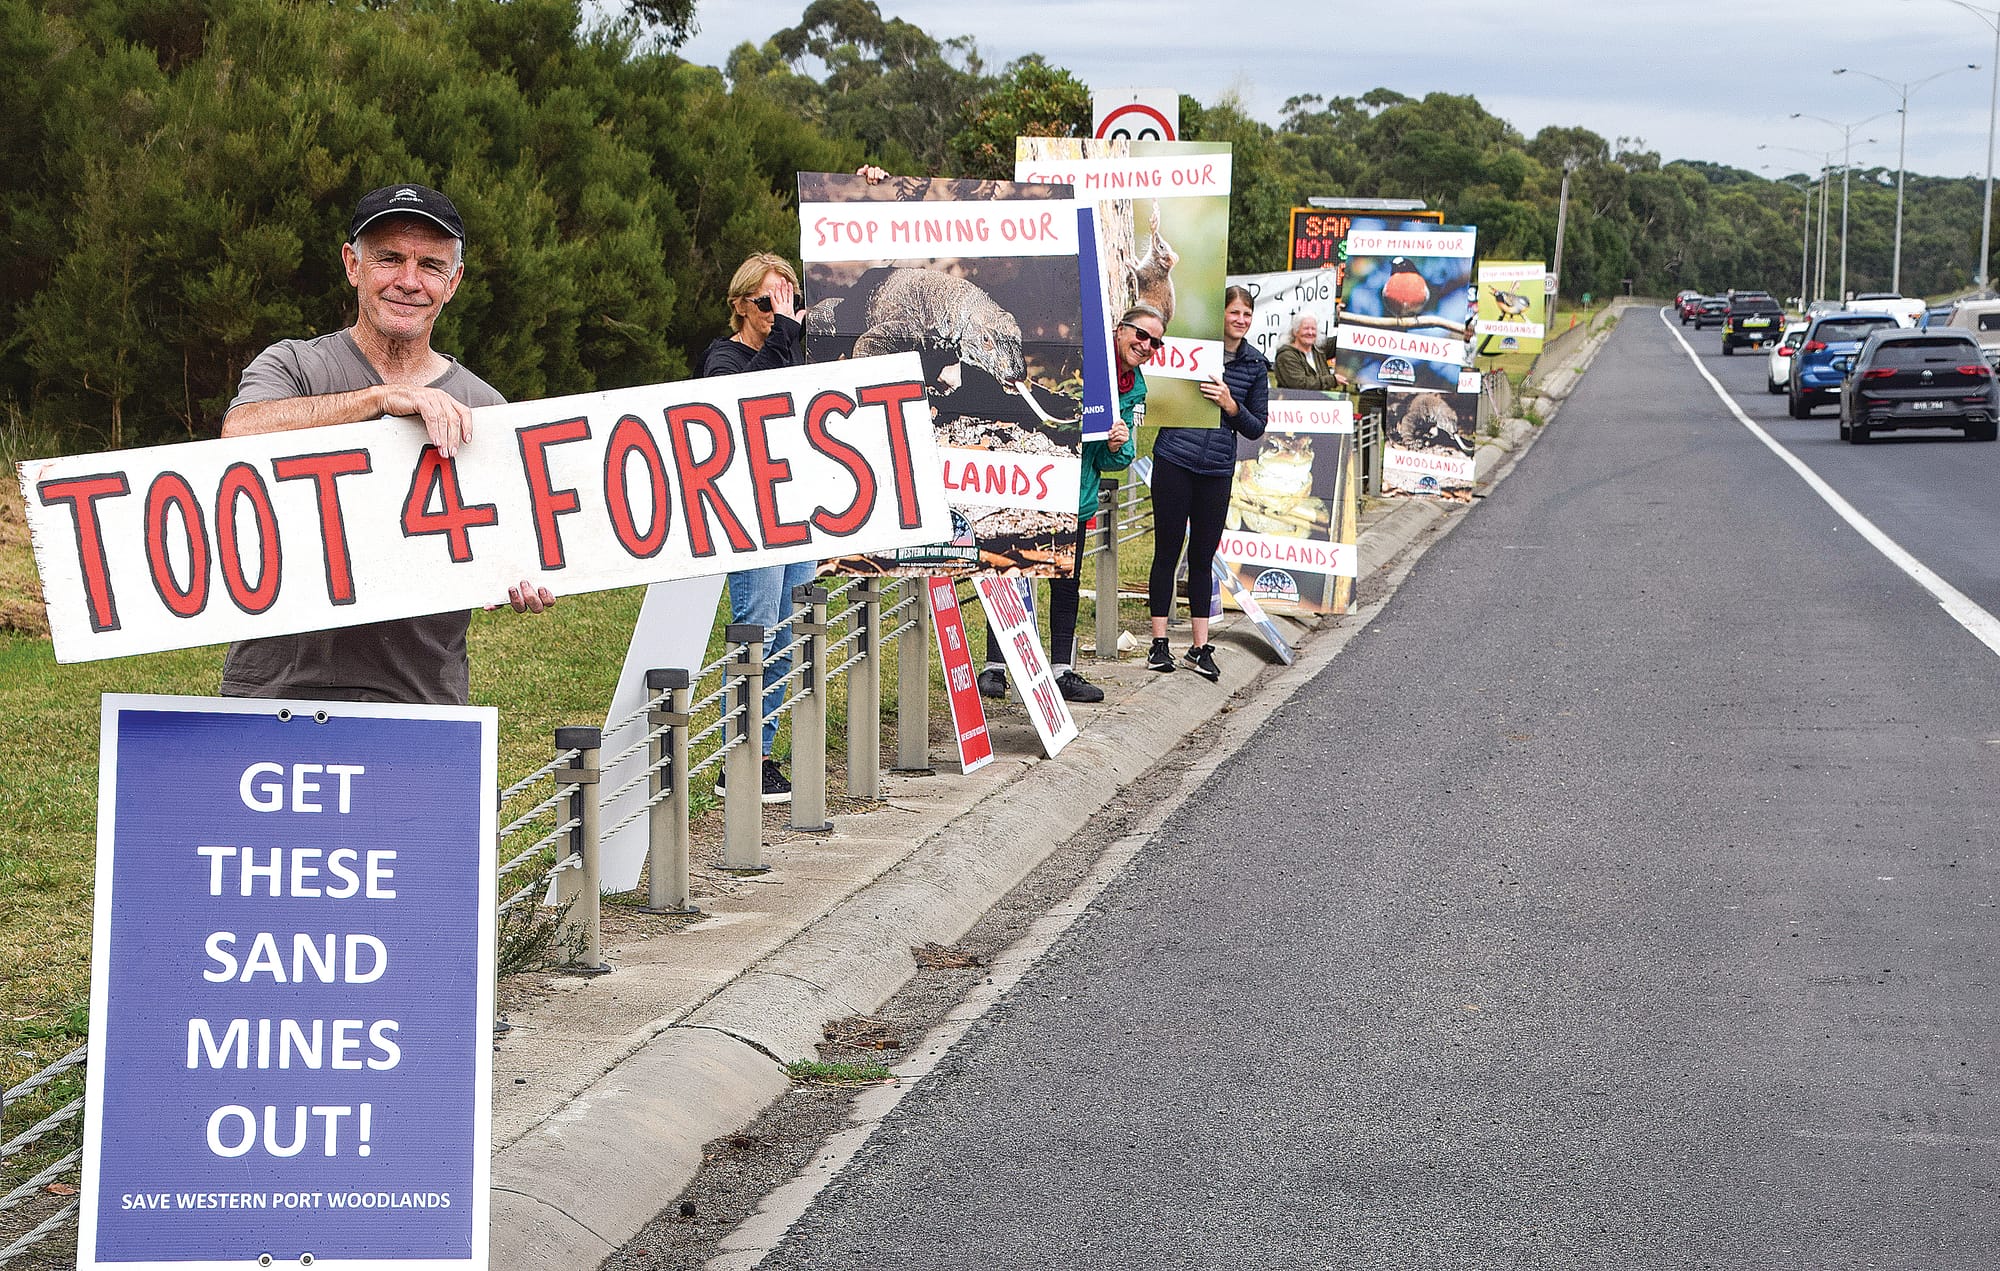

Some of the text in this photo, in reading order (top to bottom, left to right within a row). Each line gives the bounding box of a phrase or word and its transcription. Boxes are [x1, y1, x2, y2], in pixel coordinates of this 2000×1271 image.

[1085, 169, 1162, 189] MINING
[1171, 164, 1215, 185] OUR
[814, 212, 1058, 246] STOP MINING OUR
[1353, 236, 1464, 251] STOP MINING OUR
[1295, 275, 1330, 302] hole
[1265, 311, 1280, 326] in
[1352, 331, 1452, 358] WOODLANDS
[1310, 409, 1343, 425] OUR
[1395, 454, 1466, 475] WOODLANDS
[37, 380, 927, 634] TOOT 4 FOREST
[899, 546, 978, 561] WESTERN PORT WOODLANDS
[1013, 630, 1042, 682] PER
[239, 762, 365, 814] GET
[197, 846, 397, 899] THESE
[203, 931, 388, 984] SAND
[186, 1018, 402, 1071] MINES
[206, 1102, 372, 1158] OUT!
[121, 1191, 451, 1210] SAVE WESTERN PORT WOODLANDS
